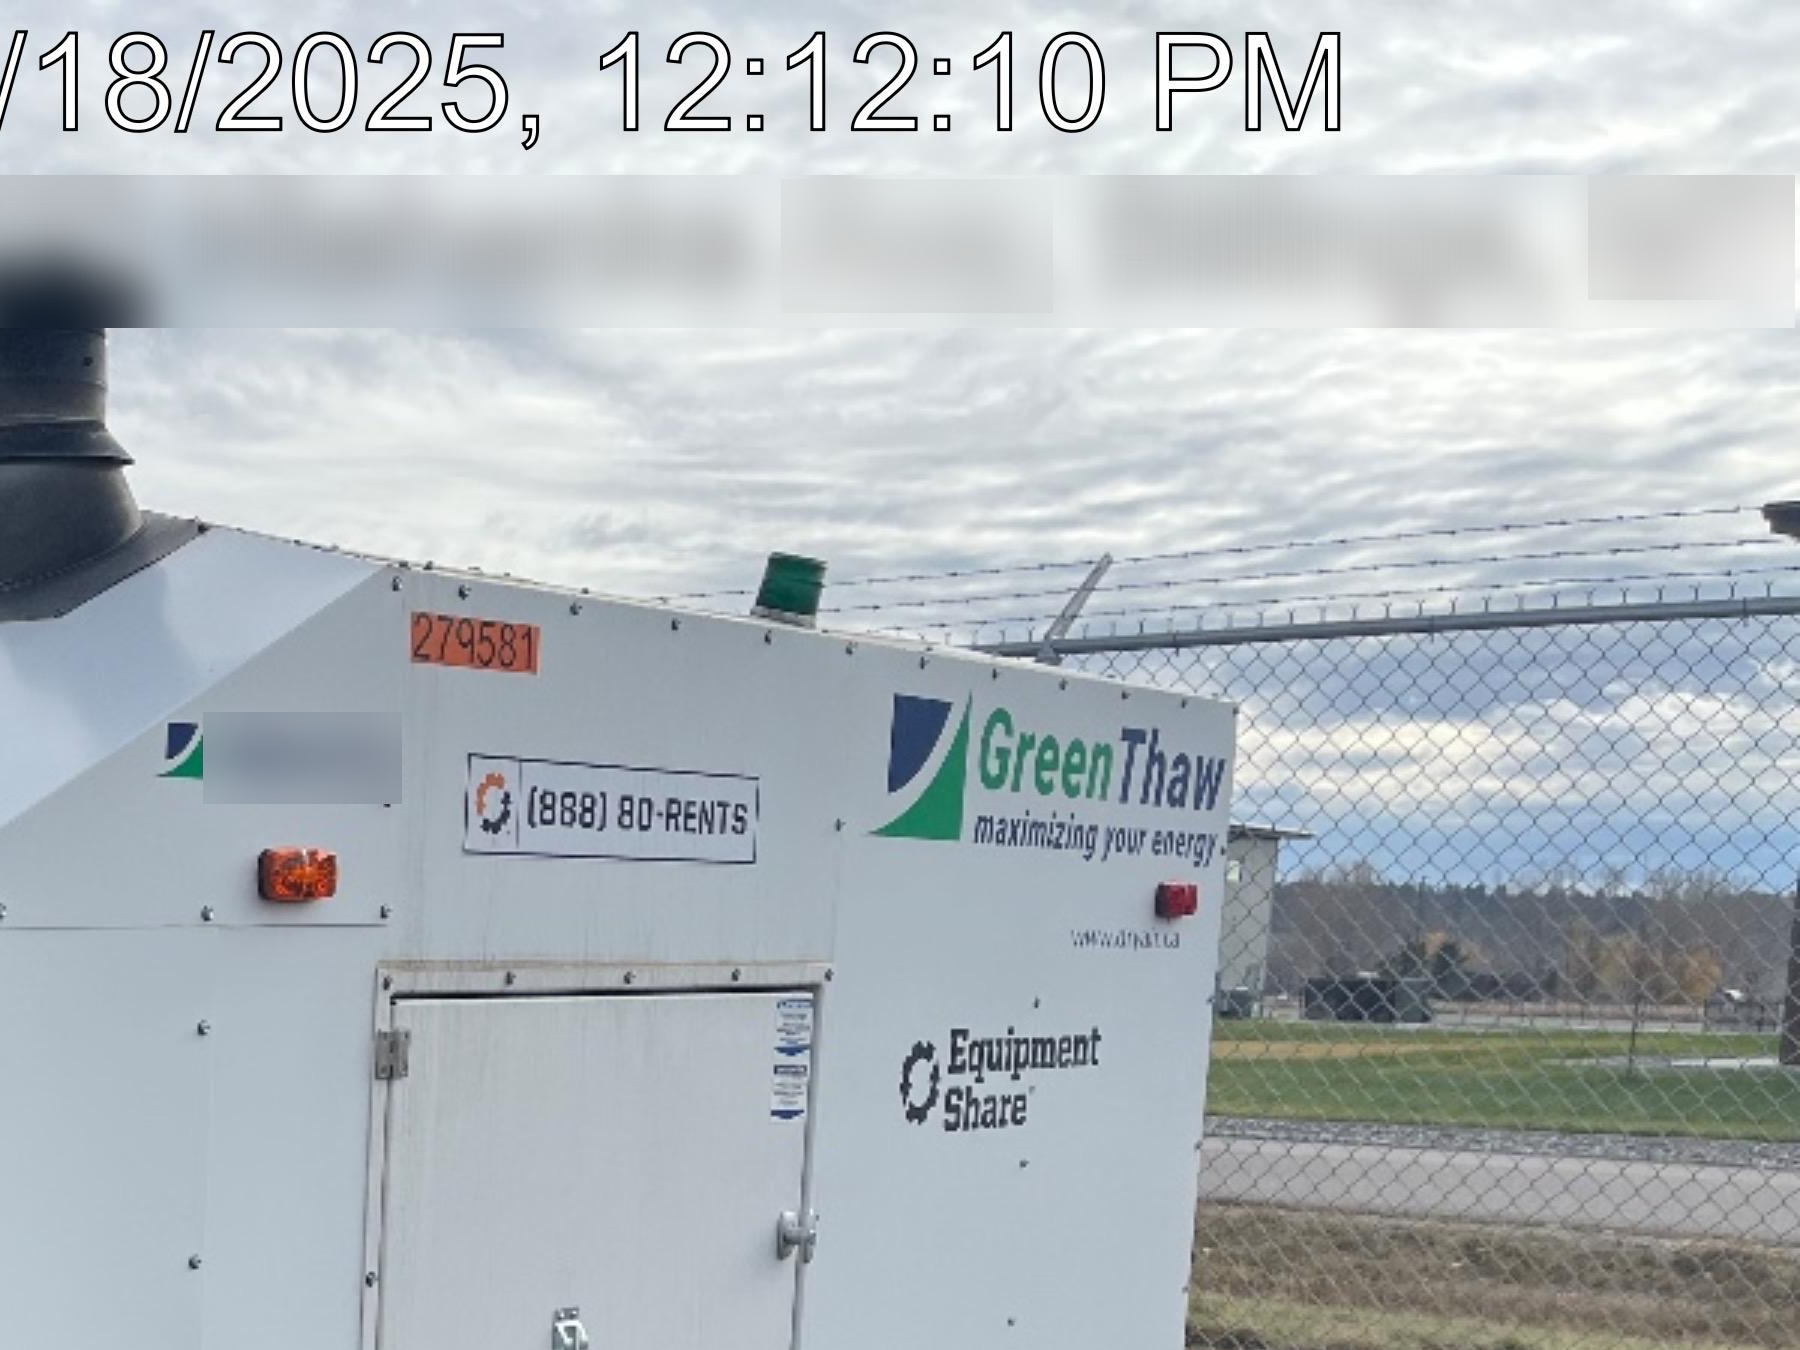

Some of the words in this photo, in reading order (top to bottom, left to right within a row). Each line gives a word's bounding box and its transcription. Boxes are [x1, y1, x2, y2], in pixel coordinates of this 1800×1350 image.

[412, 613, 534, 670] 279581
[527, 785, 607, 832] (888)
[617, 794, 748, 835] 80-RENTS
[973, 809, 1098, 862] maximizing
[1101, 828, 1147, 862] your
[1151, 829, 1219, 868] energy
[948, 1025, 1102, 1083] Equipment
[944, 1085, 1028, 1132] Share
